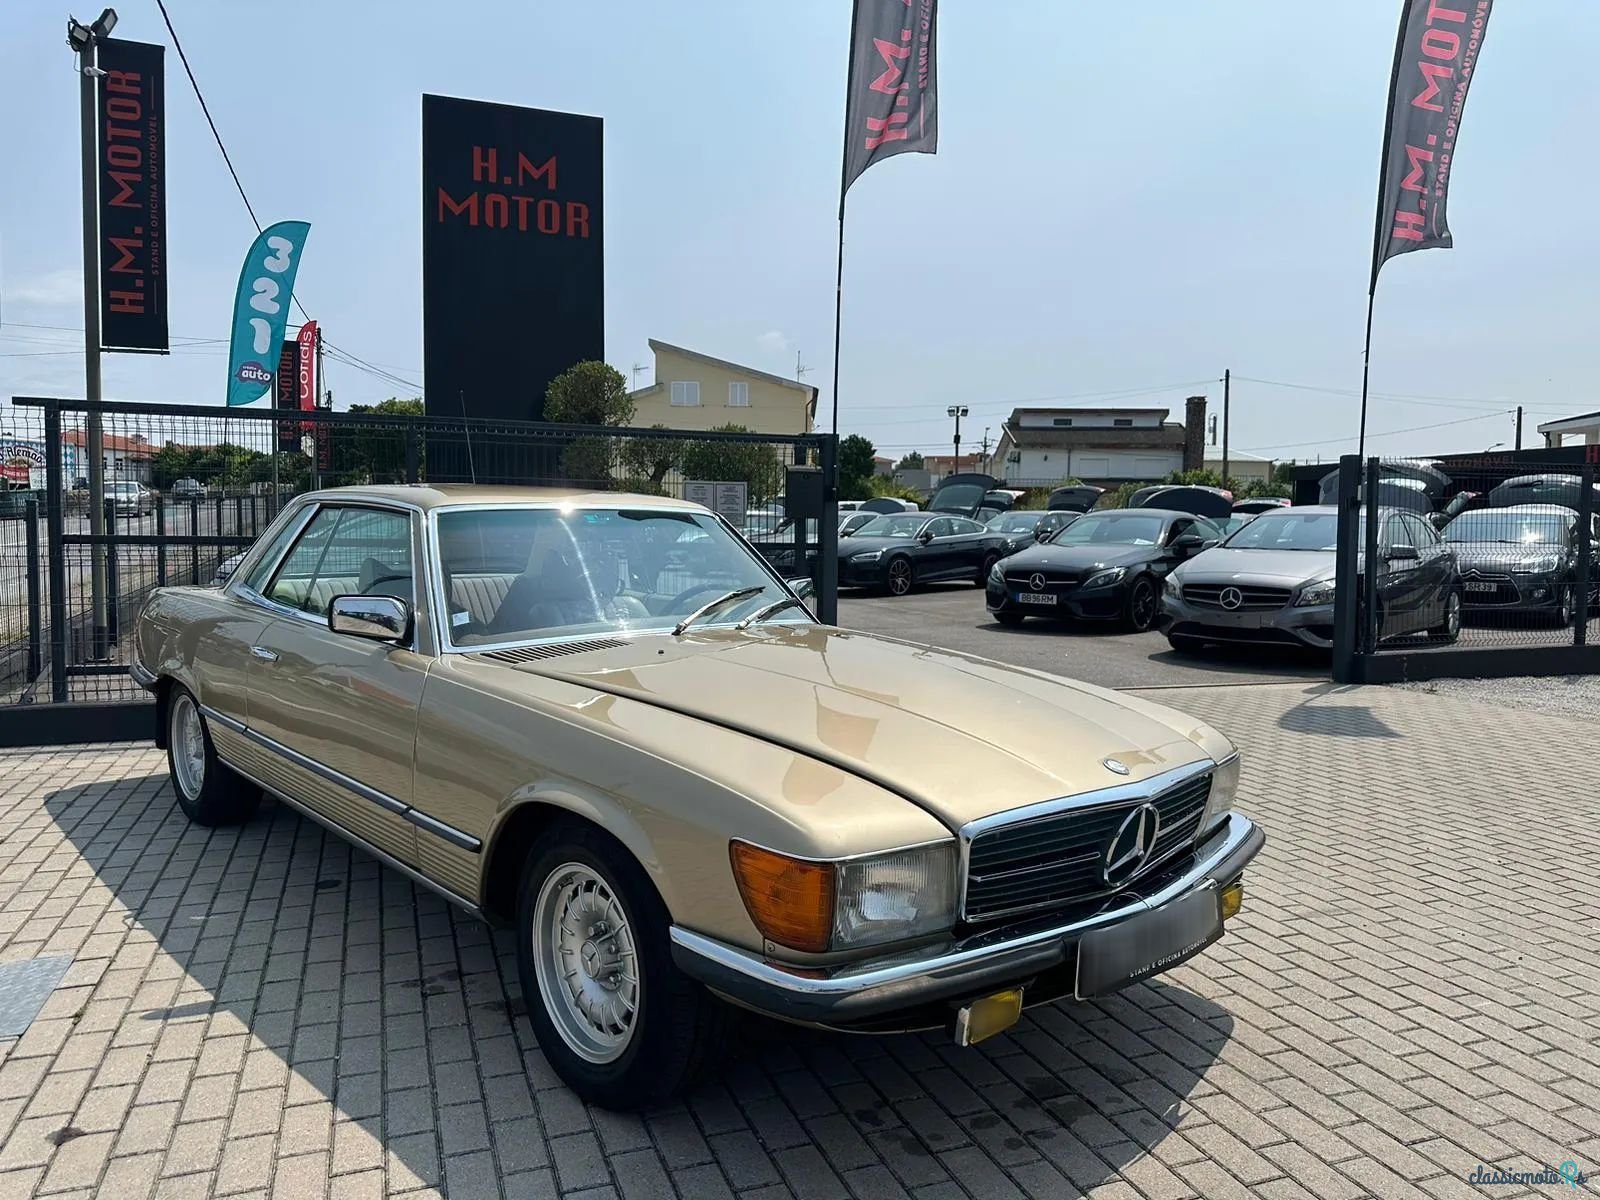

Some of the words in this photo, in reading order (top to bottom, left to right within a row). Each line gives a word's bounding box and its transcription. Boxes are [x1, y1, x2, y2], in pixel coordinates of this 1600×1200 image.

[865, 29, 912, 150] H.M.
[918, 47, 929, 89] STAND
[1445, 83, 1466, 137] OFICINA
[106, 69, 143, 209] MOTOR
[1443, 141, 1452, 149] E
[472, 146, 557, 190] H.M
[1392, 133, 1438, 242] H.M.
[1435, 153, 1450, 197] STAND
[150, 183, 159, 228] OFICINA
[438, 187, 590, 238] MOTOR
[151, 230, 159, 238] E
[109, 226, 145, 314] H.M.
[151, 241, 160, 276] STAND
[241, 369, 271, 382] auto
[279, 351, 293, 401] MOTOR
